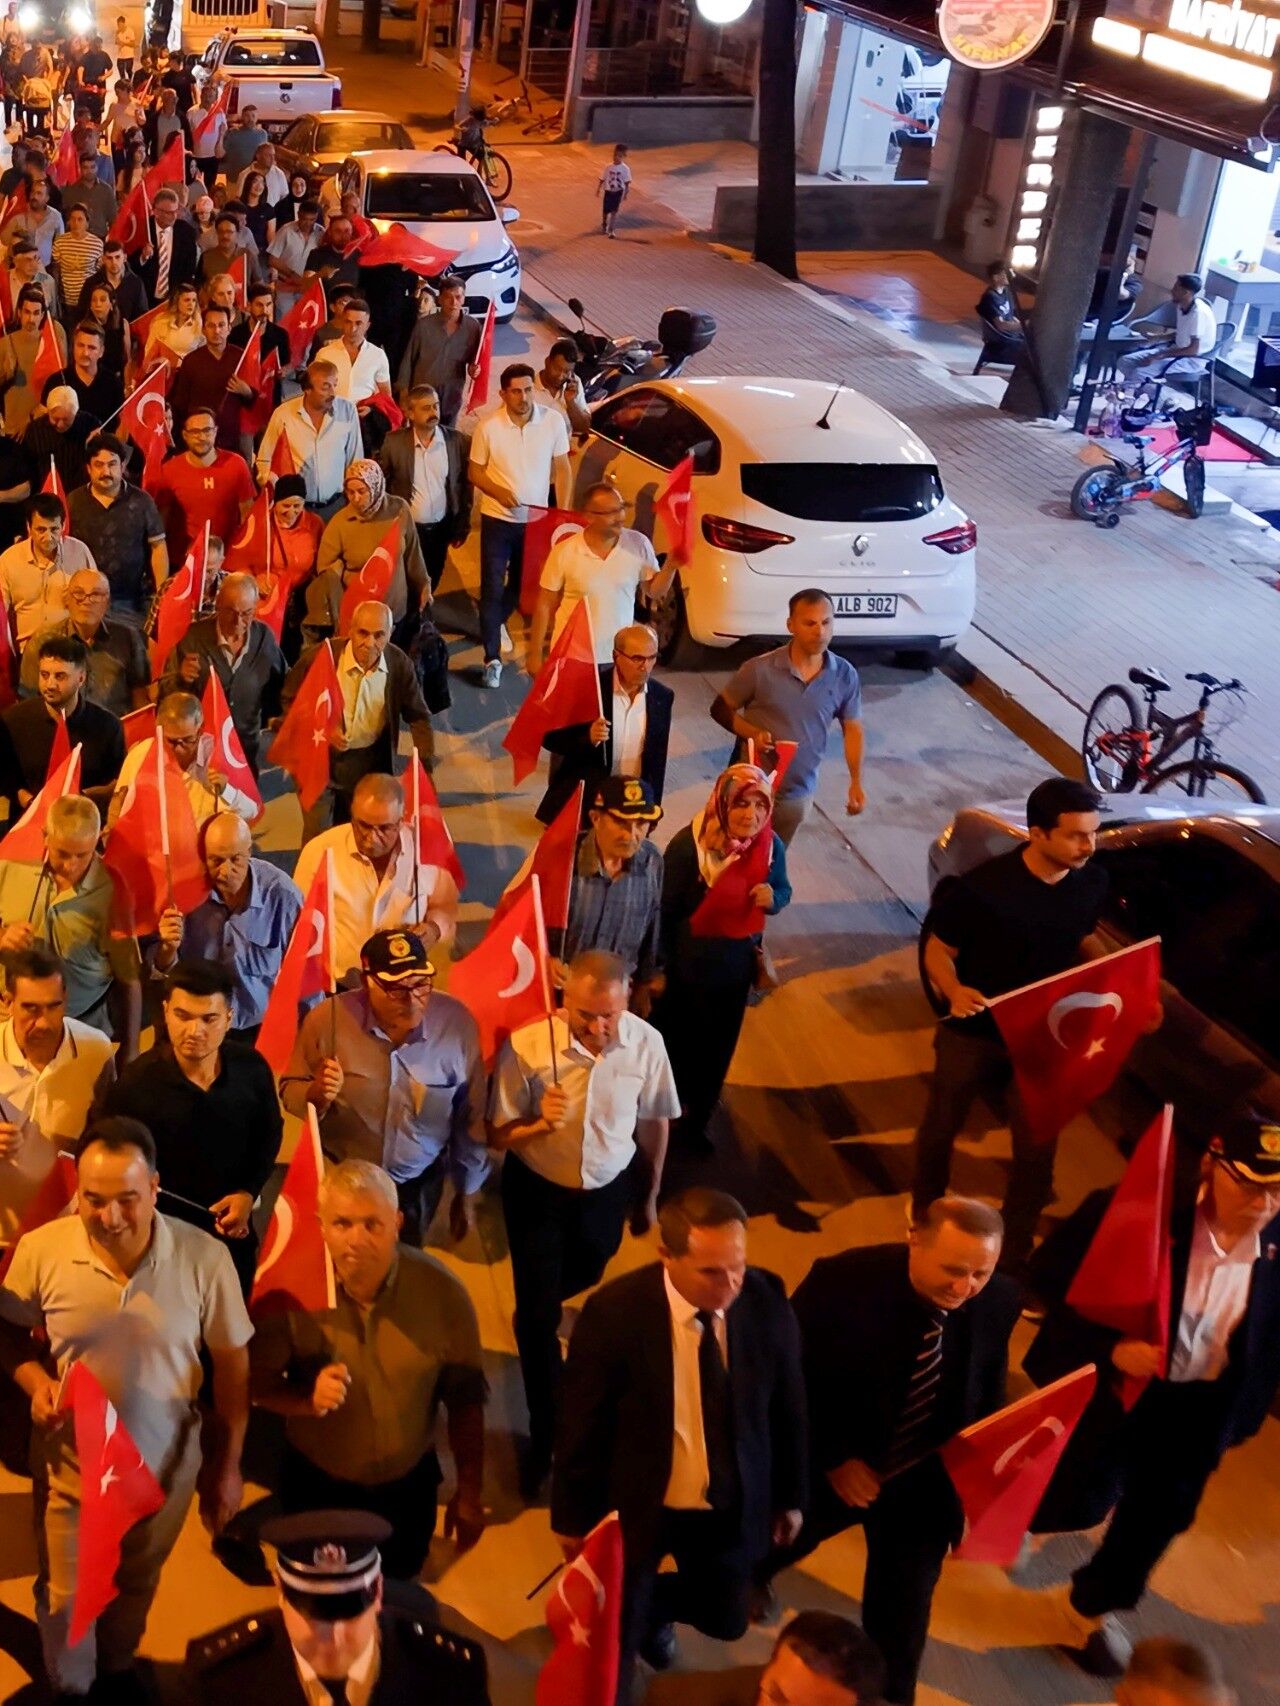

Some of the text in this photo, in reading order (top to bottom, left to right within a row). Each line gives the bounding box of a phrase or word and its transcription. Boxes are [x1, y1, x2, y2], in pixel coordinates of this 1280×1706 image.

[203, 476, 215, 490] H
[836, 597, 893, 613] ALB 902
